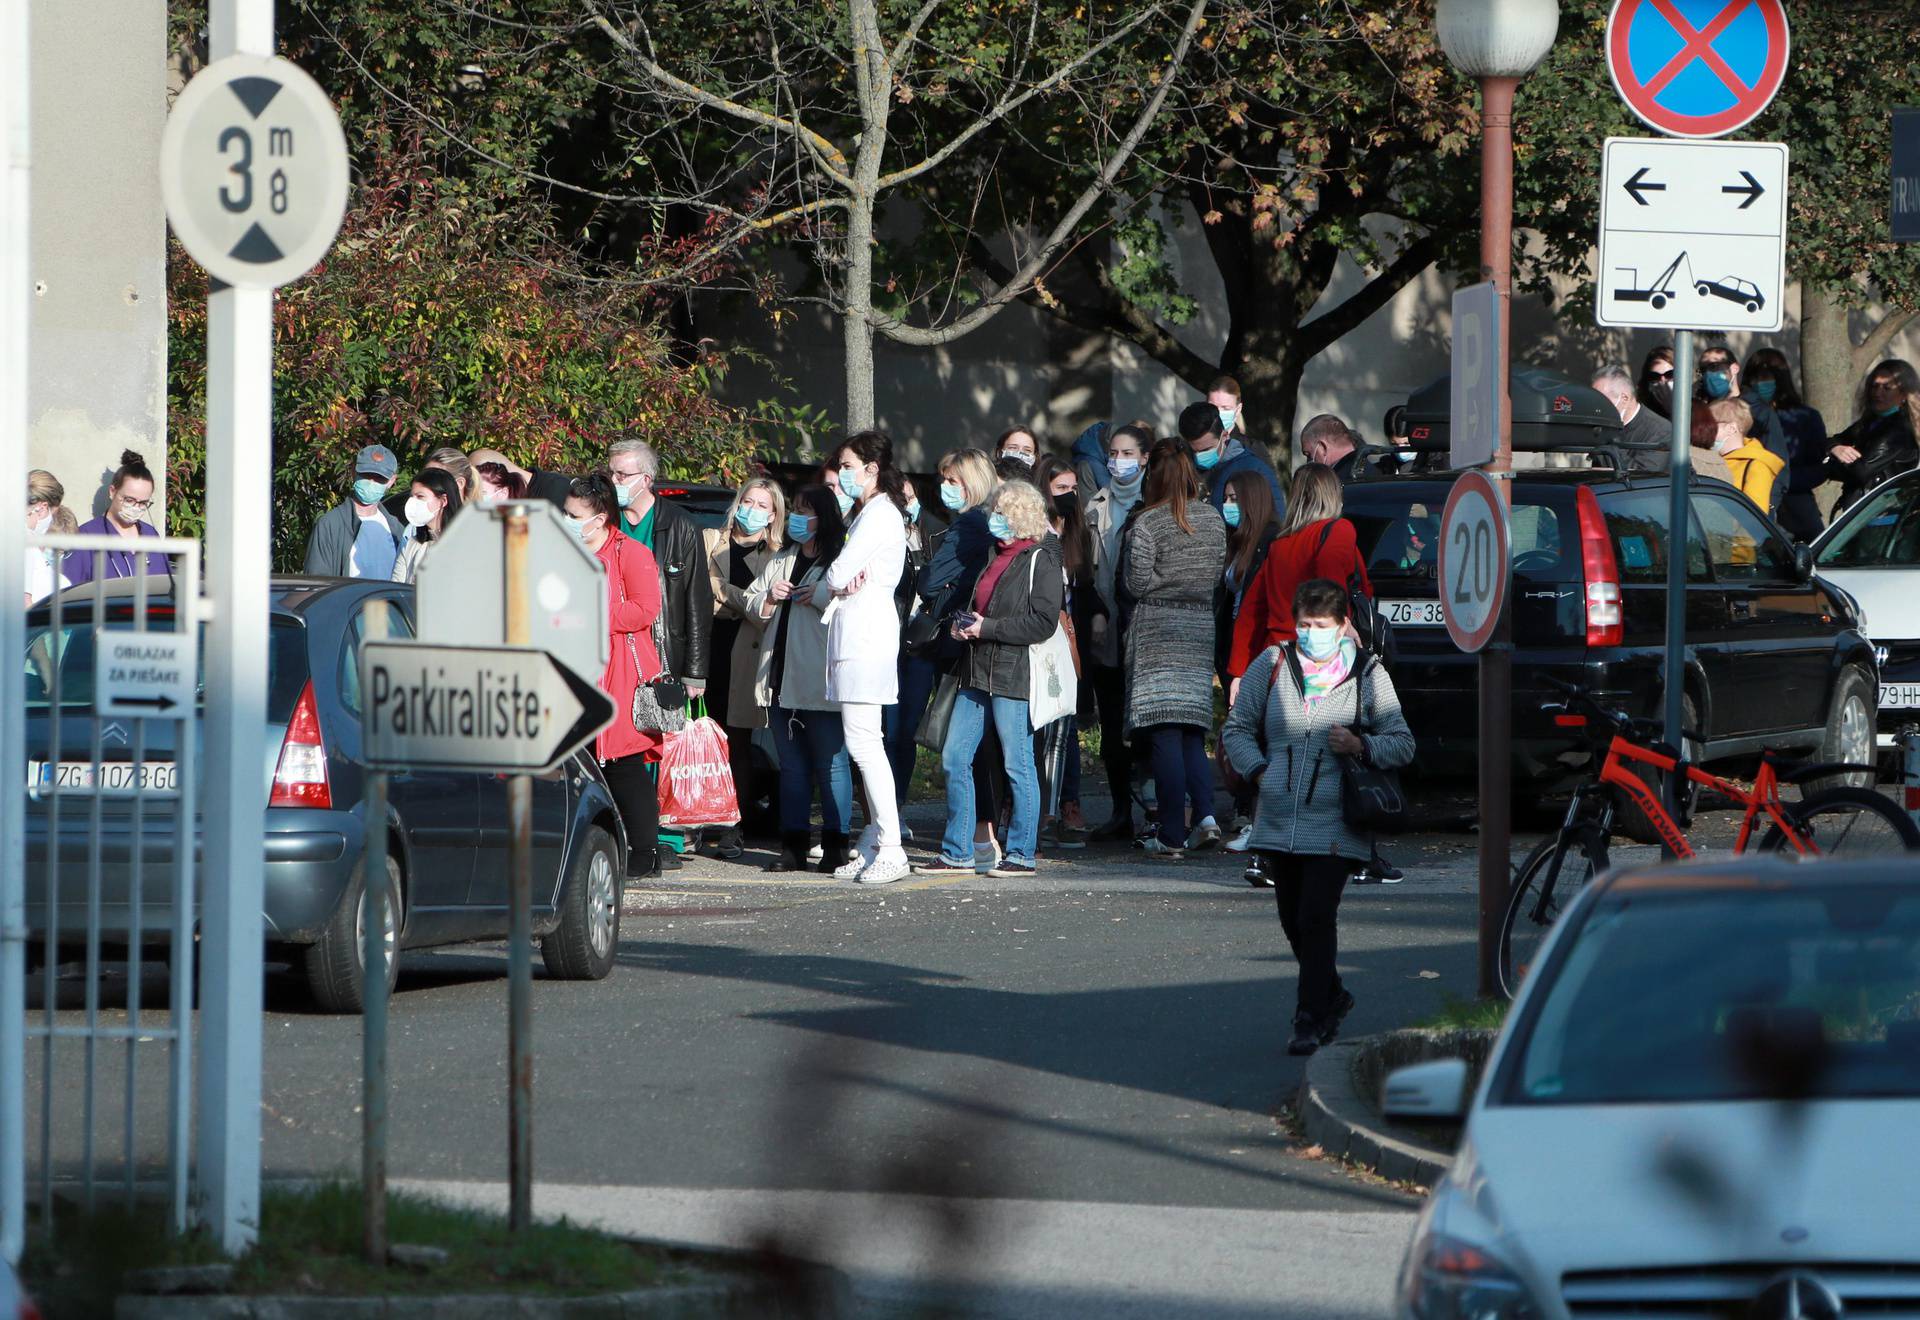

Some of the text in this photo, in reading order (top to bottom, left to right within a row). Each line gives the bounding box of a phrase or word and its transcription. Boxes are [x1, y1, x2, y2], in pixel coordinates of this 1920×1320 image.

[218, 126, 293, 214] 3 m
[270, 167, 287, 215] 8
[1461, 312, 1482, 442] P
[1455, 518, 1491, 604] 20
[1525, 591, 1575, 599] HR-V
[1390, 603, 1411, 622] ZG
[113, 645, 176, 661] OBILAZAK
[109, 666, 126, 682] ZA
[372, 665, 540, 741] Parkiralište
[56, 766, 81, 788] ZG
[670, 762, 733, 780] KONZUM
